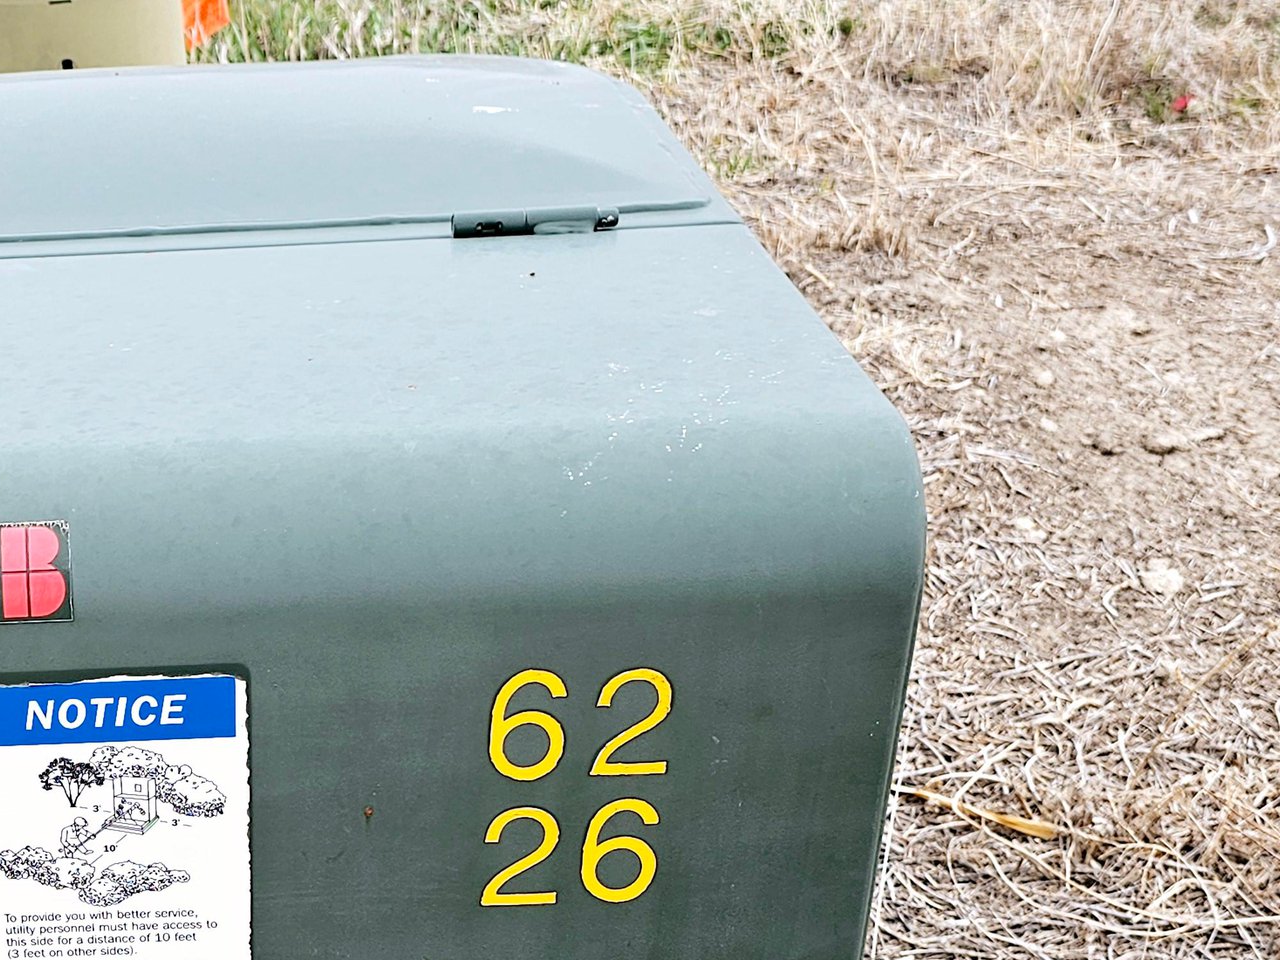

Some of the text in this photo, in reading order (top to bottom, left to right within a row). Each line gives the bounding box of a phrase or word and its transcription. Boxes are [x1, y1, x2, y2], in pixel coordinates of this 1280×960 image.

[25, 694, 187, 731] NOTICE
[489, 668, 673, 781] 62
[480, 797, 660, 906] 26
[4, 909, 198, 923] To provide you with better service,
[6, 920, 218, 936] utility personnel must have access to
[7, 937, 27, 947] this
[31, 936, 53, 946] side
[57, 936, 72, 945] for
[88, 934, 135, 944] distance
[139, 933, 150, 942] of
[155, 933, 170, 942] 10
[174, 932, 197, 941] feet
[7, 949, 19, 959] (3
[24, 949, 45, 958] feet
[67, 947, 96, 957] other
[100, 945, 137, 956] sides).
